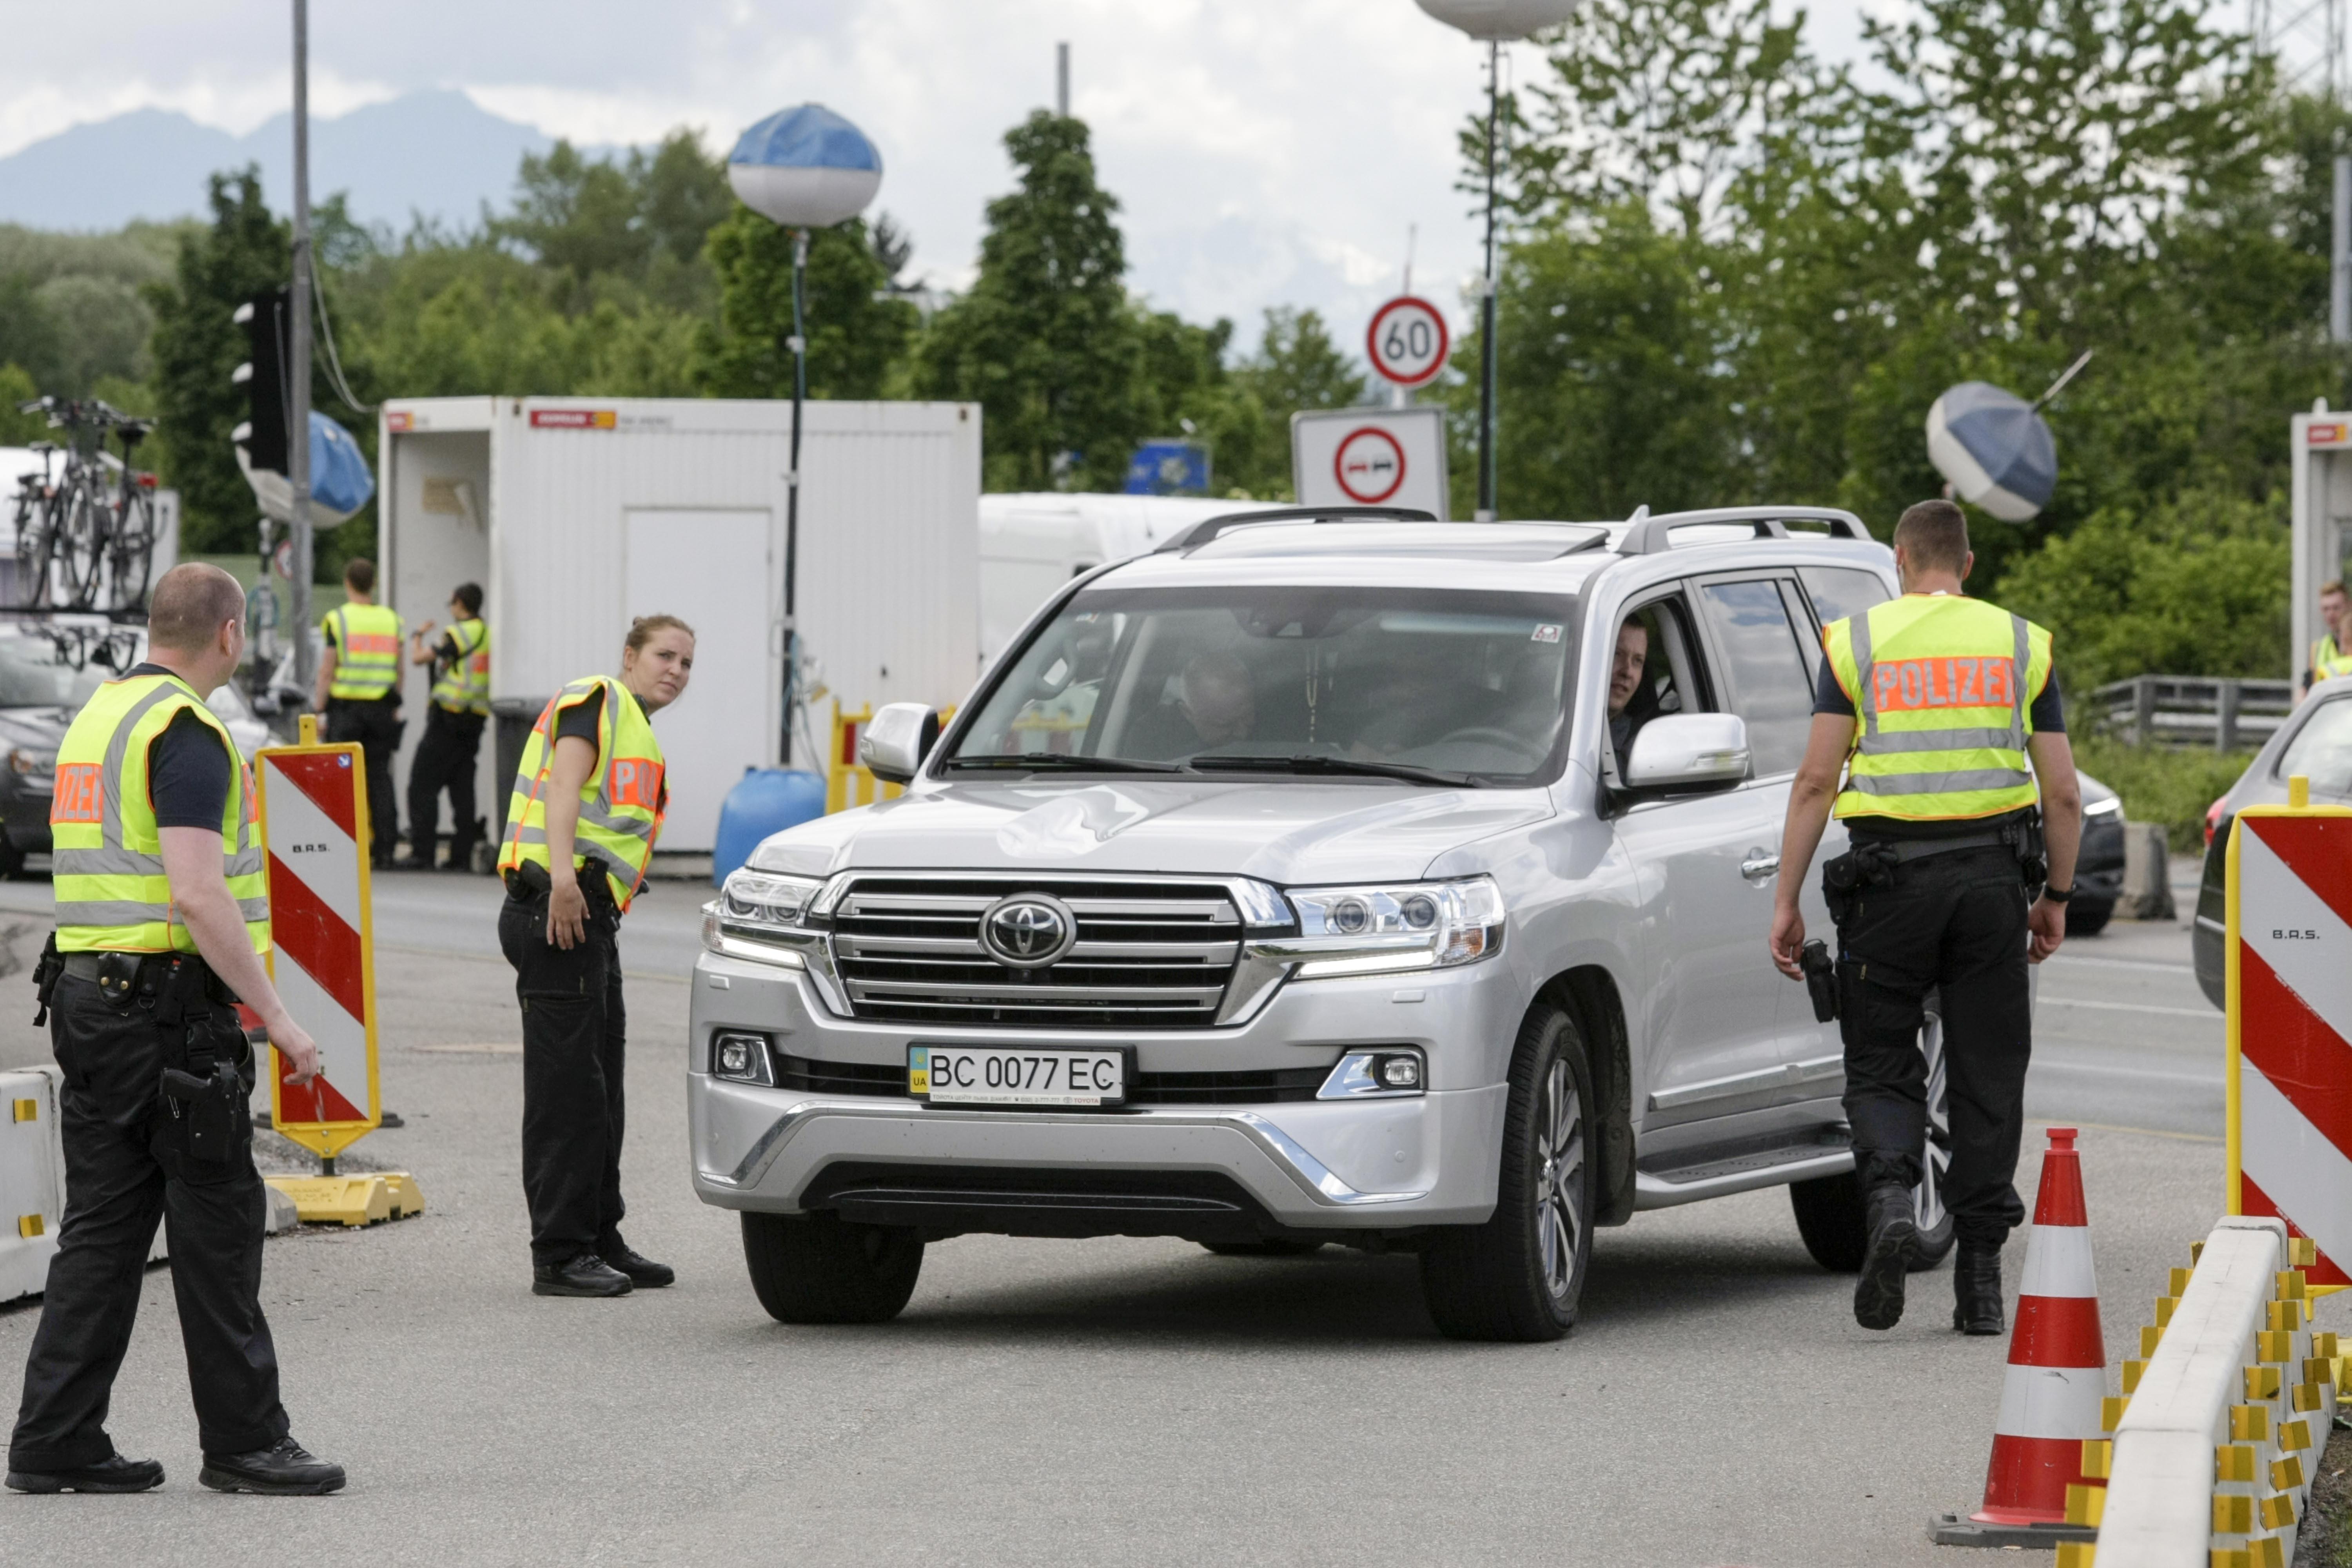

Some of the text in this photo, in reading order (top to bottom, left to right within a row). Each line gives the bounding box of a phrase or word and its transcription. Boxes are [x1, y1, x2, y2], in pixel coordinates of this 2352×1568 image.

[1385, 320, 1430, 361] 60
[1876, 659, 2012, 708] POLIZEI
[2273, 930, 2320, 939] B.A.S.
[913, 1077, 926, 1086] UA
[931, 1055, 1114, 1091] BC 0077 EC
